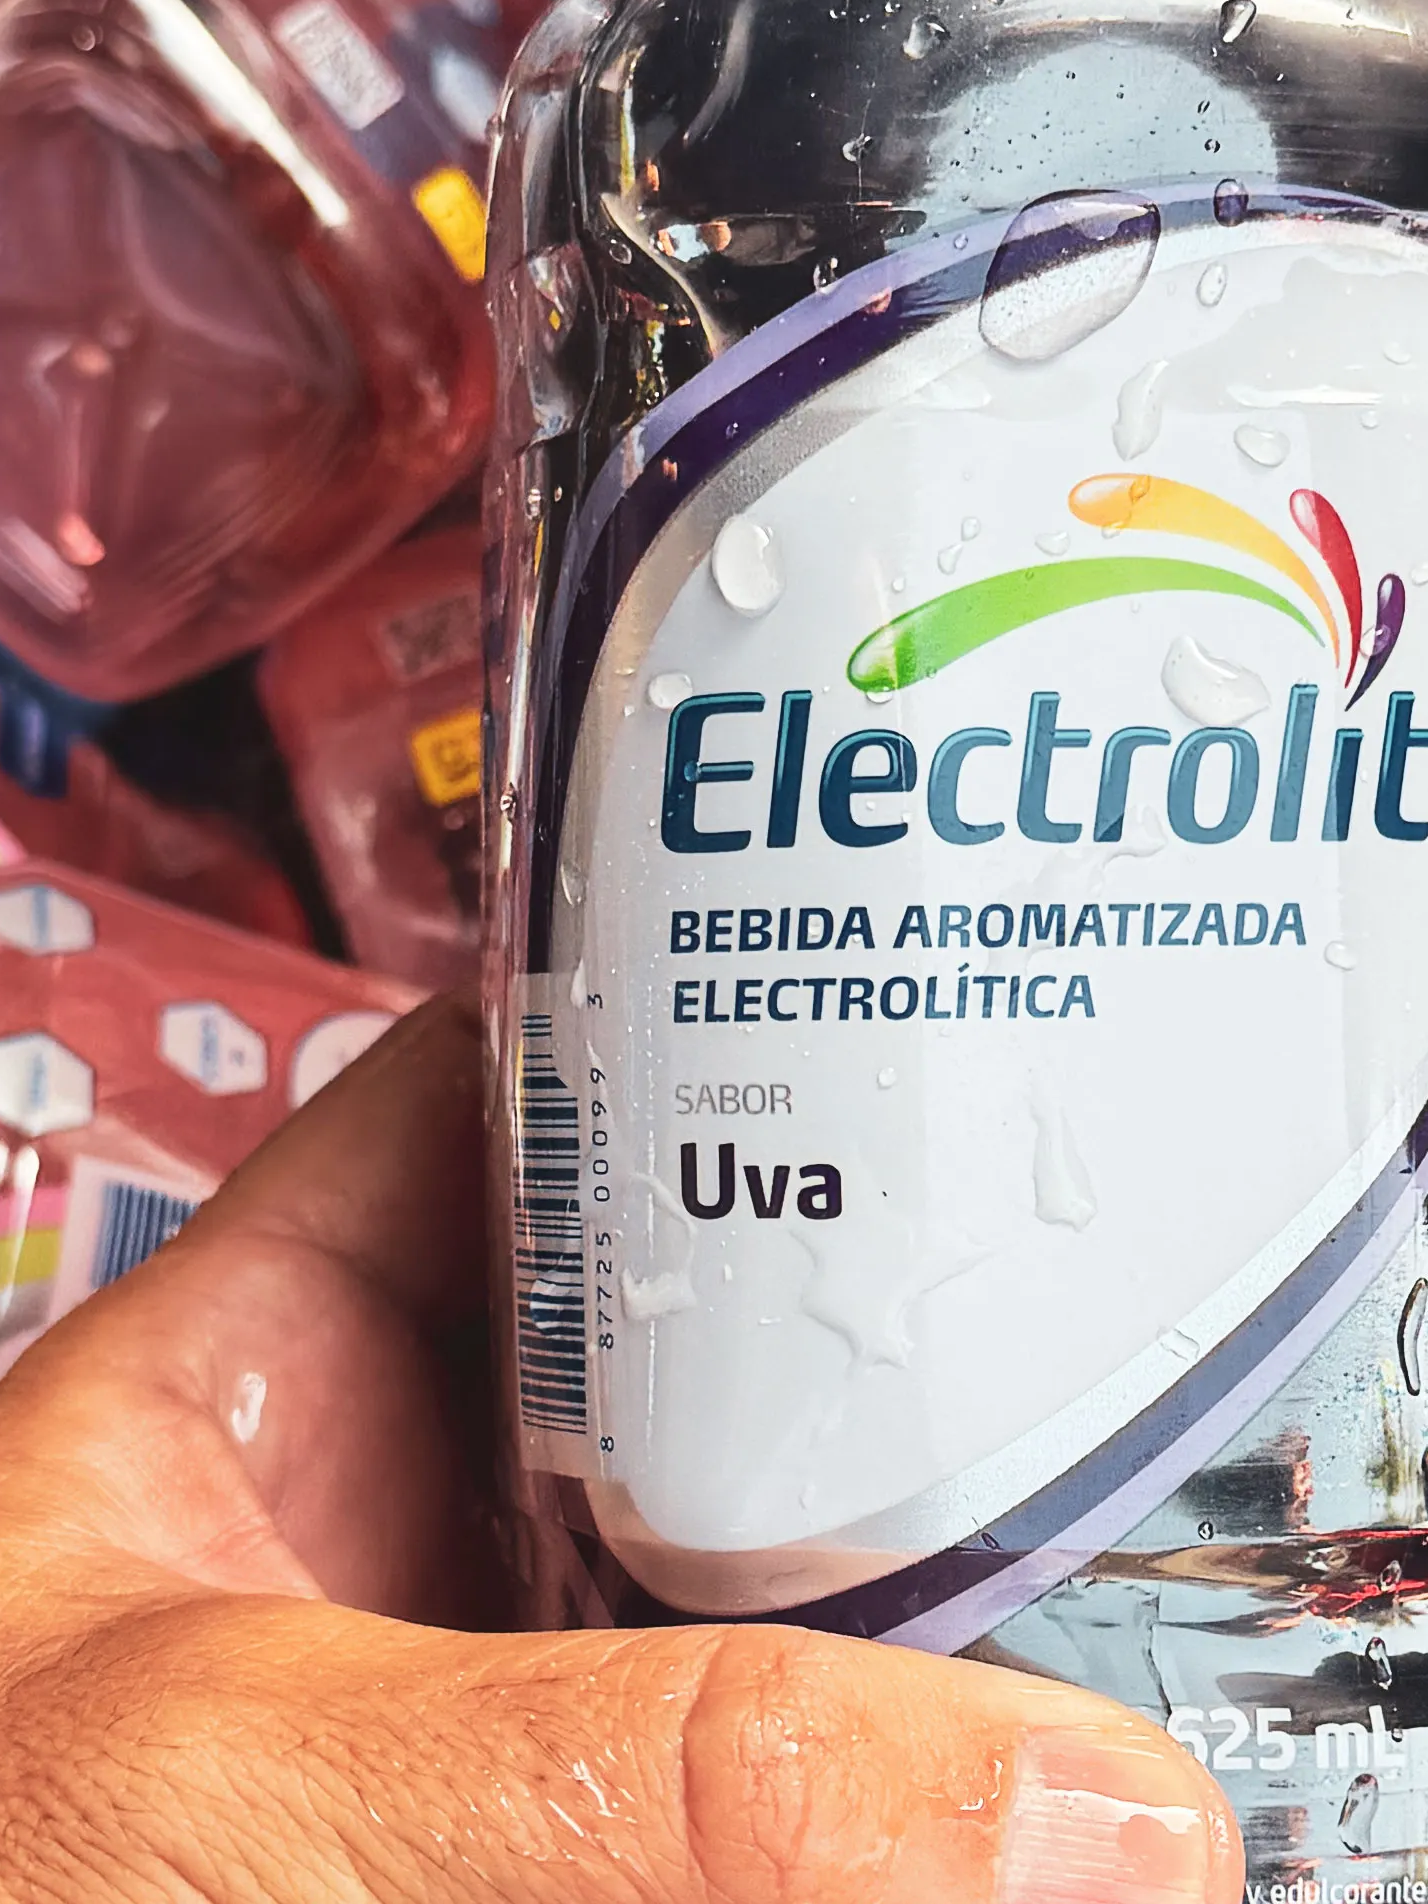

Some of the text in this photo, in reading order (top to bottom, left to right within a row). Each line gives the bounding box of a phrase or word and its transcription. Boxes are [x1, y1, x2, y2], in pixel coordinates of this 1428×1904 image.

[670, 902, 1307, 955] BEBIDA AROMATIZADA
[673, 963, 1096, 1025] ELECTROLÍTICA
[674, 1082, 793, 1116] SABOR
[678, 1142, 844, 1221] Uva
[1315, 1704, 1406, 1770] mL
